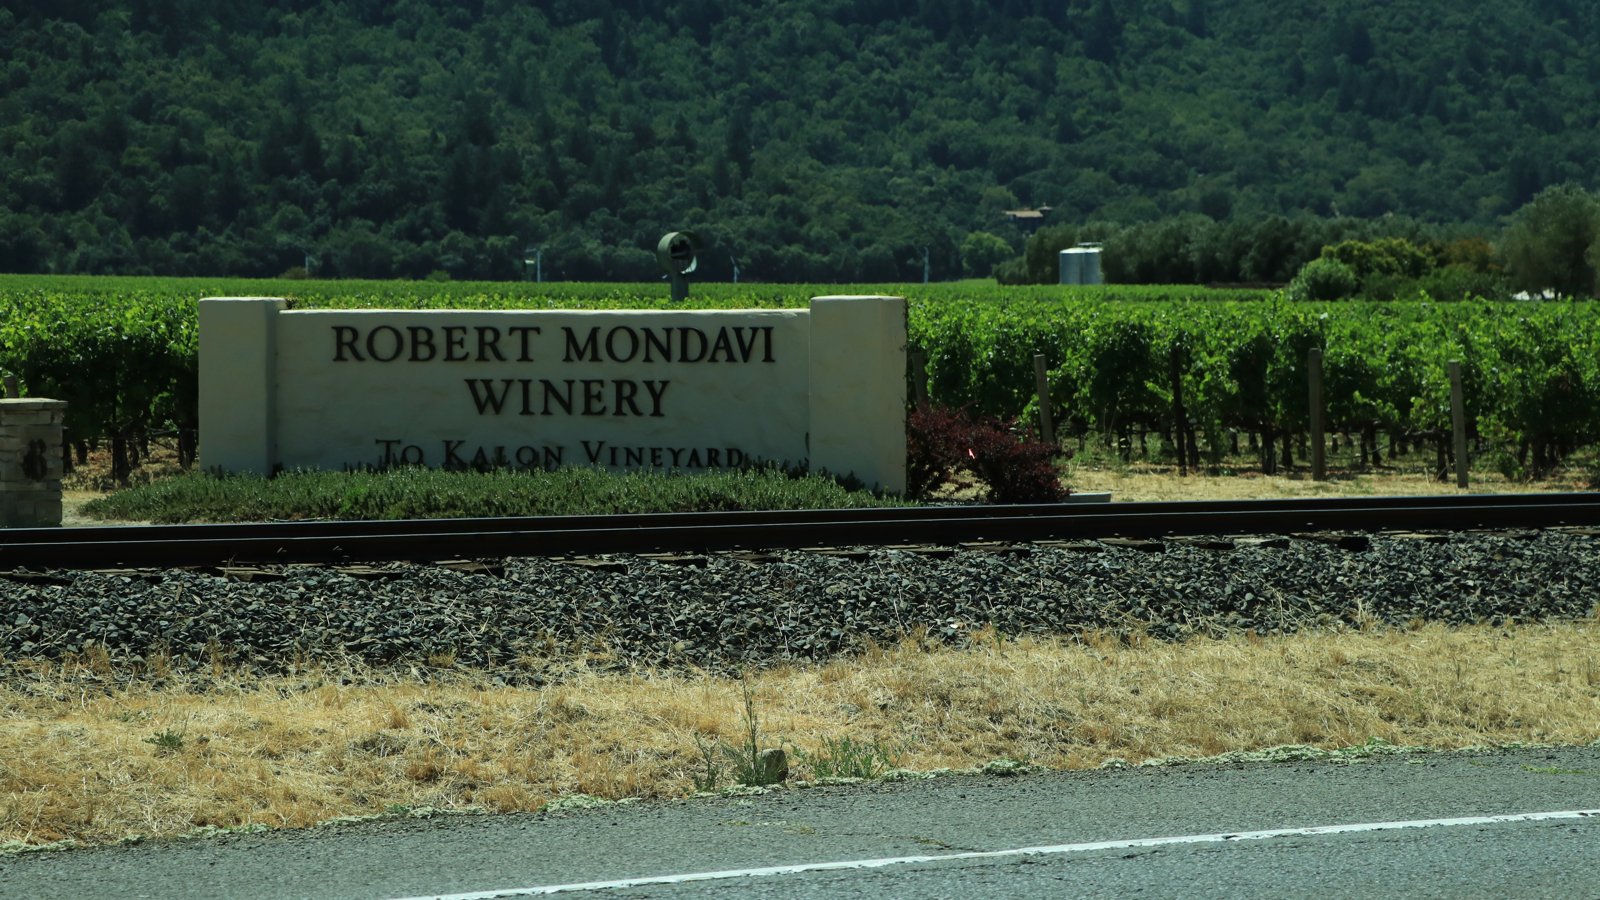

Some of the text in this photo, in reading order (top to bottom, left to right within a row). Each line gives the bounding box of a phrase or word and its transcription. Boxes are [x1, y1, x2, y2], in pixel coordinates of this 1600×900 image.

[331, 325, 776, 363] ROBERT MONDAVI
[464, 378, 671, 417] WINERY
